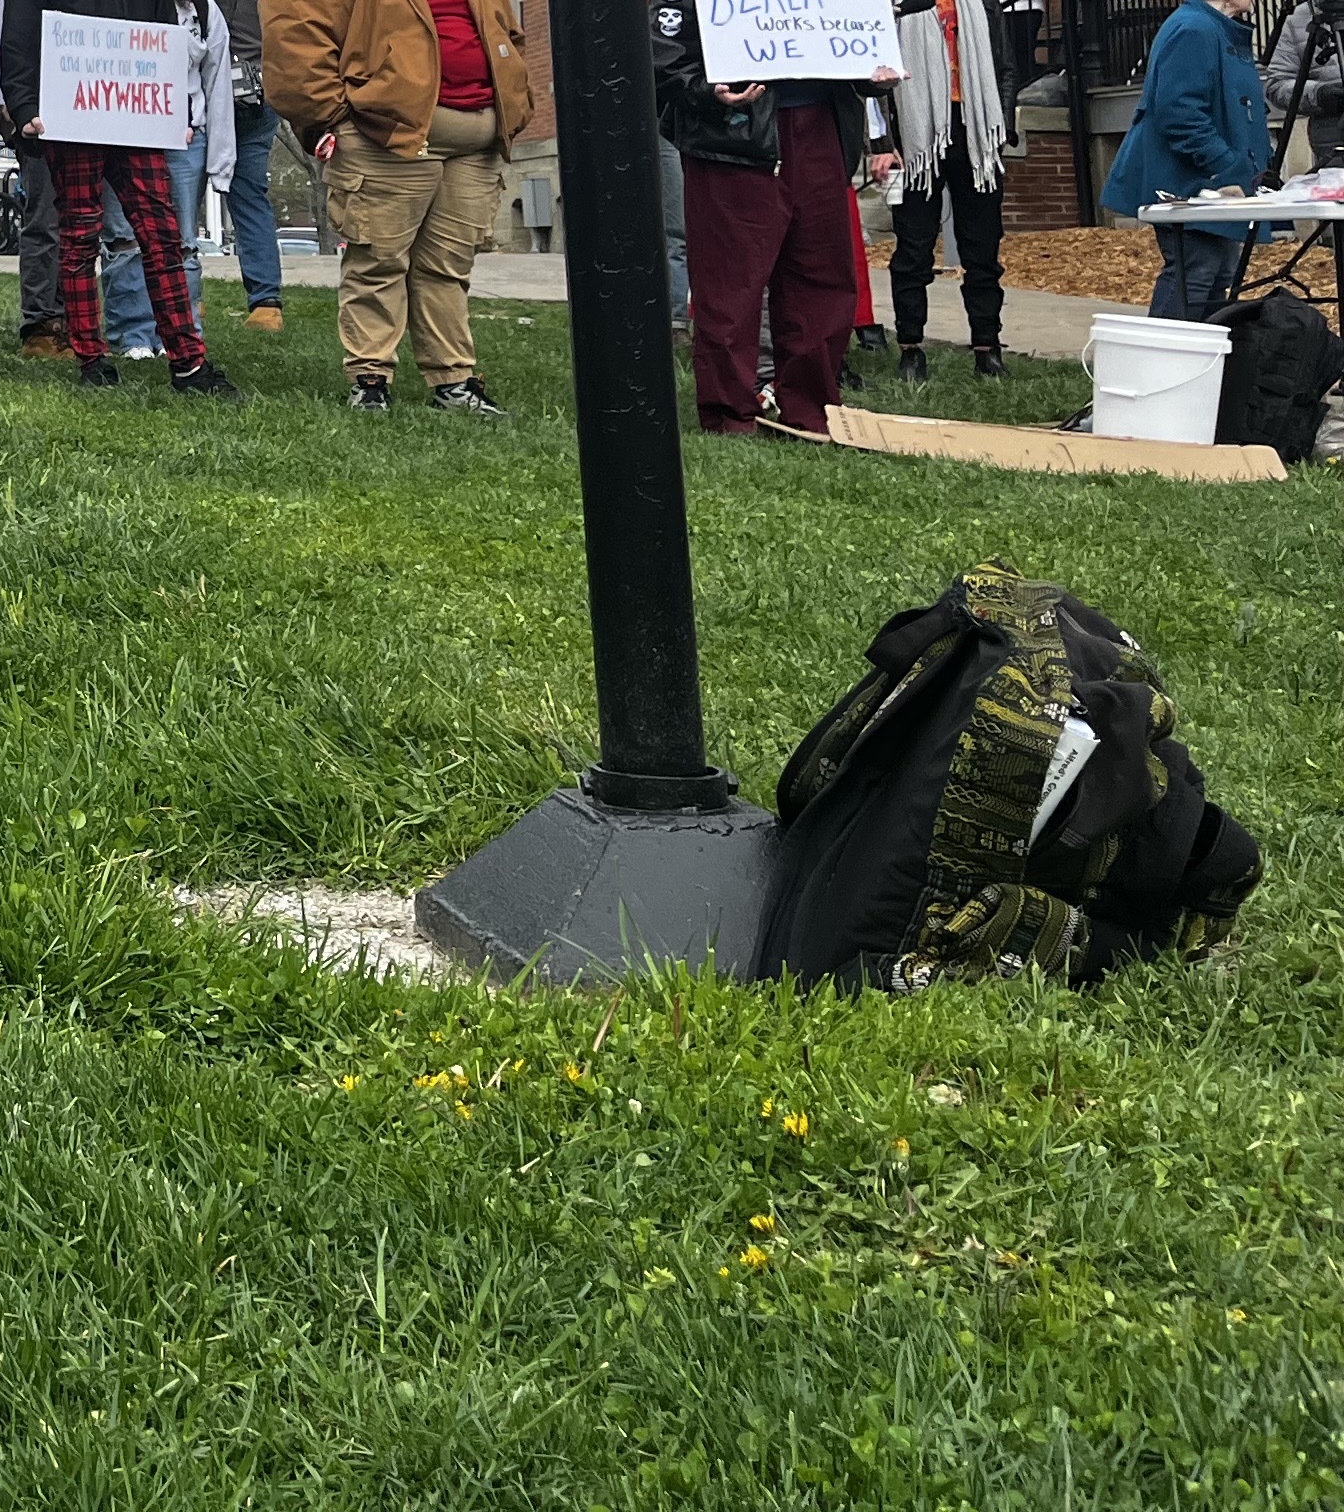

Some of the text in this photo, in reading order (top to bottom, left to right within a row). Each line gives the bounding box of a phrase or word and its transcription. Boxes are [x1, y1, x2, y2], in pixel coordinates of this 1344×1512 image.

[52, 20, 169, 54] Berea is our HOME
[743, 35, 879, 63] WE DO!
[60, 55, 158, 78] and we're not going
[72, 79, 175, 116] ANYWHERE
